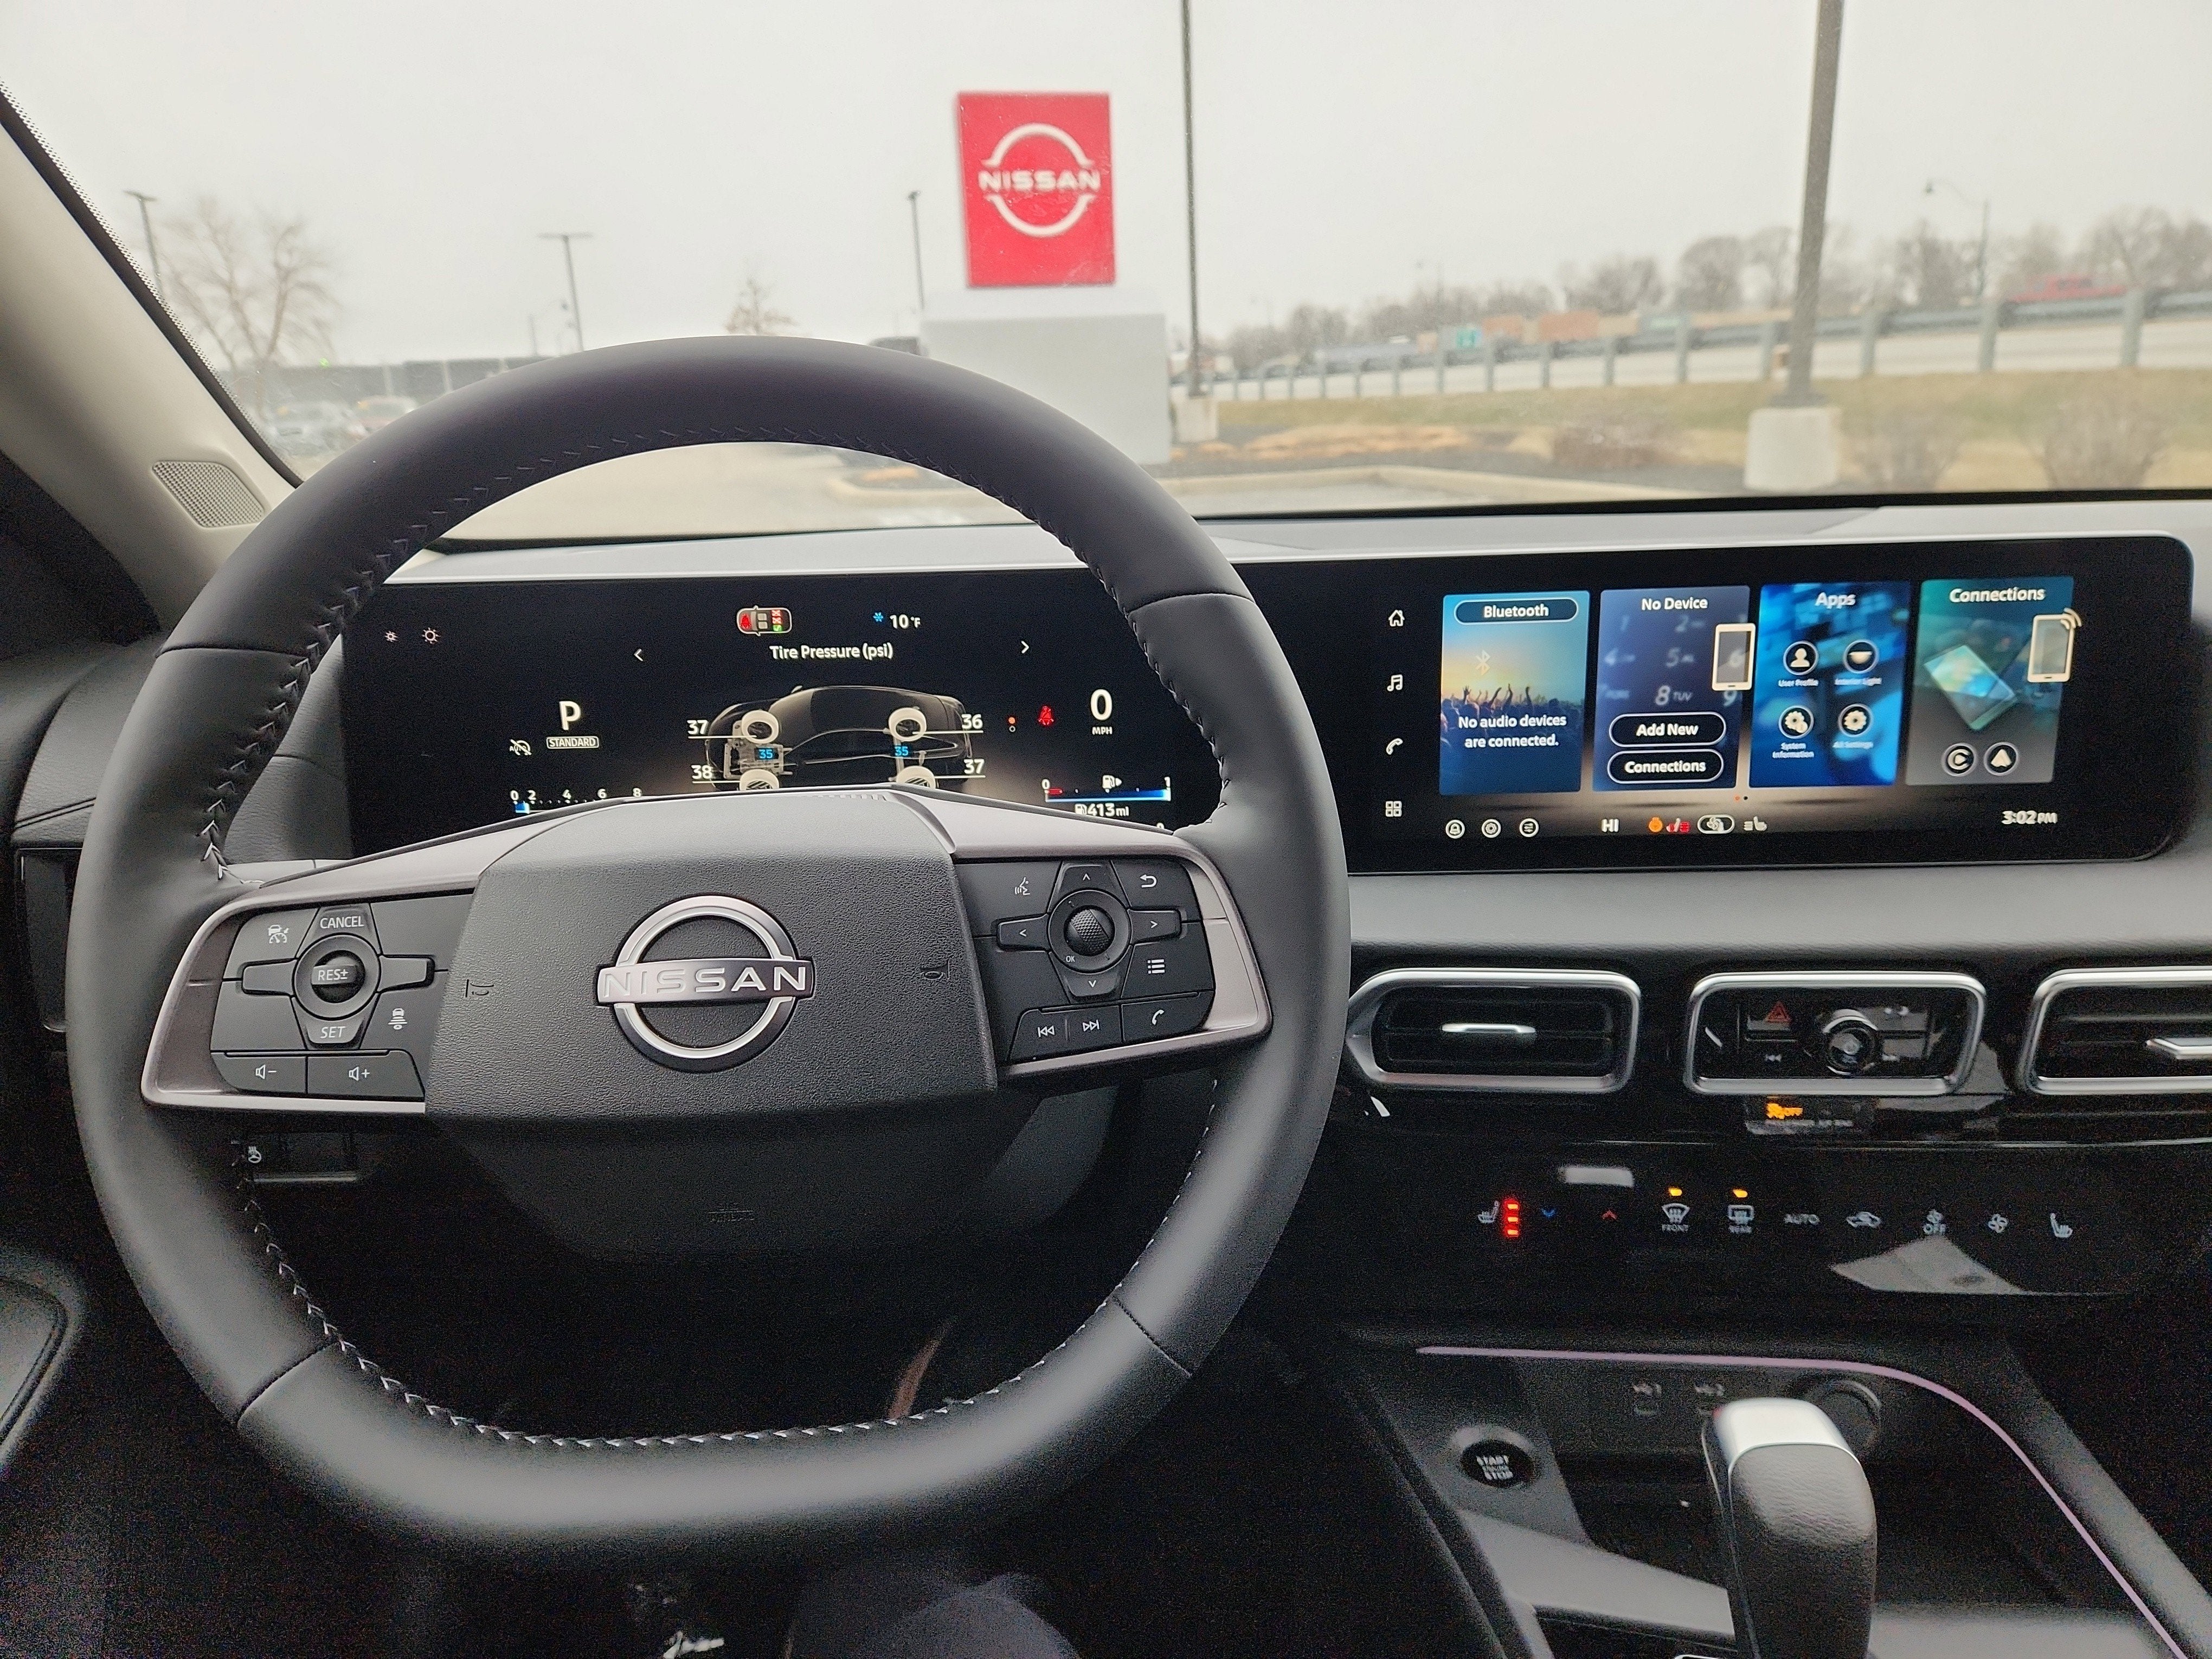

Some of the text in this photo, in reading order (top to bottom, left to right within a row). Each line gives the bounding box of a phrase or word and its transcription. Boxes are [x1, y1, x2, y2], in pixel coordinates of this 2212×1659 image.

[978, 169, 1101, 192] NISSAN
[1816, 593, 1855, 609] Apps
[1950, 587, 2044, 603] Connections
[1642, 597, 1708, 610] No Device
[1483, 605, 1549, 619] Bluetooth
[890, 615, 909, 628] 10
[770, 642, 894, 660] Tire Pressure (psi)
[1655, 685, 1670, 705] 8
[1090, 689, 1113, 721] 0
[559, 700, 581, 730] P
[961, 714, 983, 730] 36
[1459, 714, 1566, 729] No audio devices
[687, 719, 707, 735] 37
[1092, 726, 1113, 735] MPH
[1636, 723, 1698, 737] Add New
[549, 737, 596, 748] STANDARD
[1464, 735, 1559, 748] are connected.
[758, 749, 773, 759] 35
[895, 746, 909, 756] 35
[691, 764, 713, 780] 38
[964, 759, 985, 775] 37
[1625, 760, 1706, 774] Connections
[1041, 779, 1050, 790] 0
[1165, 777, 1171, 788] 1
[510, 787, 641, 801] 0 2 4 6 8
[1088, 803, 1115, 817] 413
[2002, 811, 2057, 825] 3:02 PM
[1602, 819, 1619, 832] HI
[320, 916, 364, 929] CANCEL
[604, 967, 805, 998] NISSAN
[321, 1026, 346, 1038] SET
